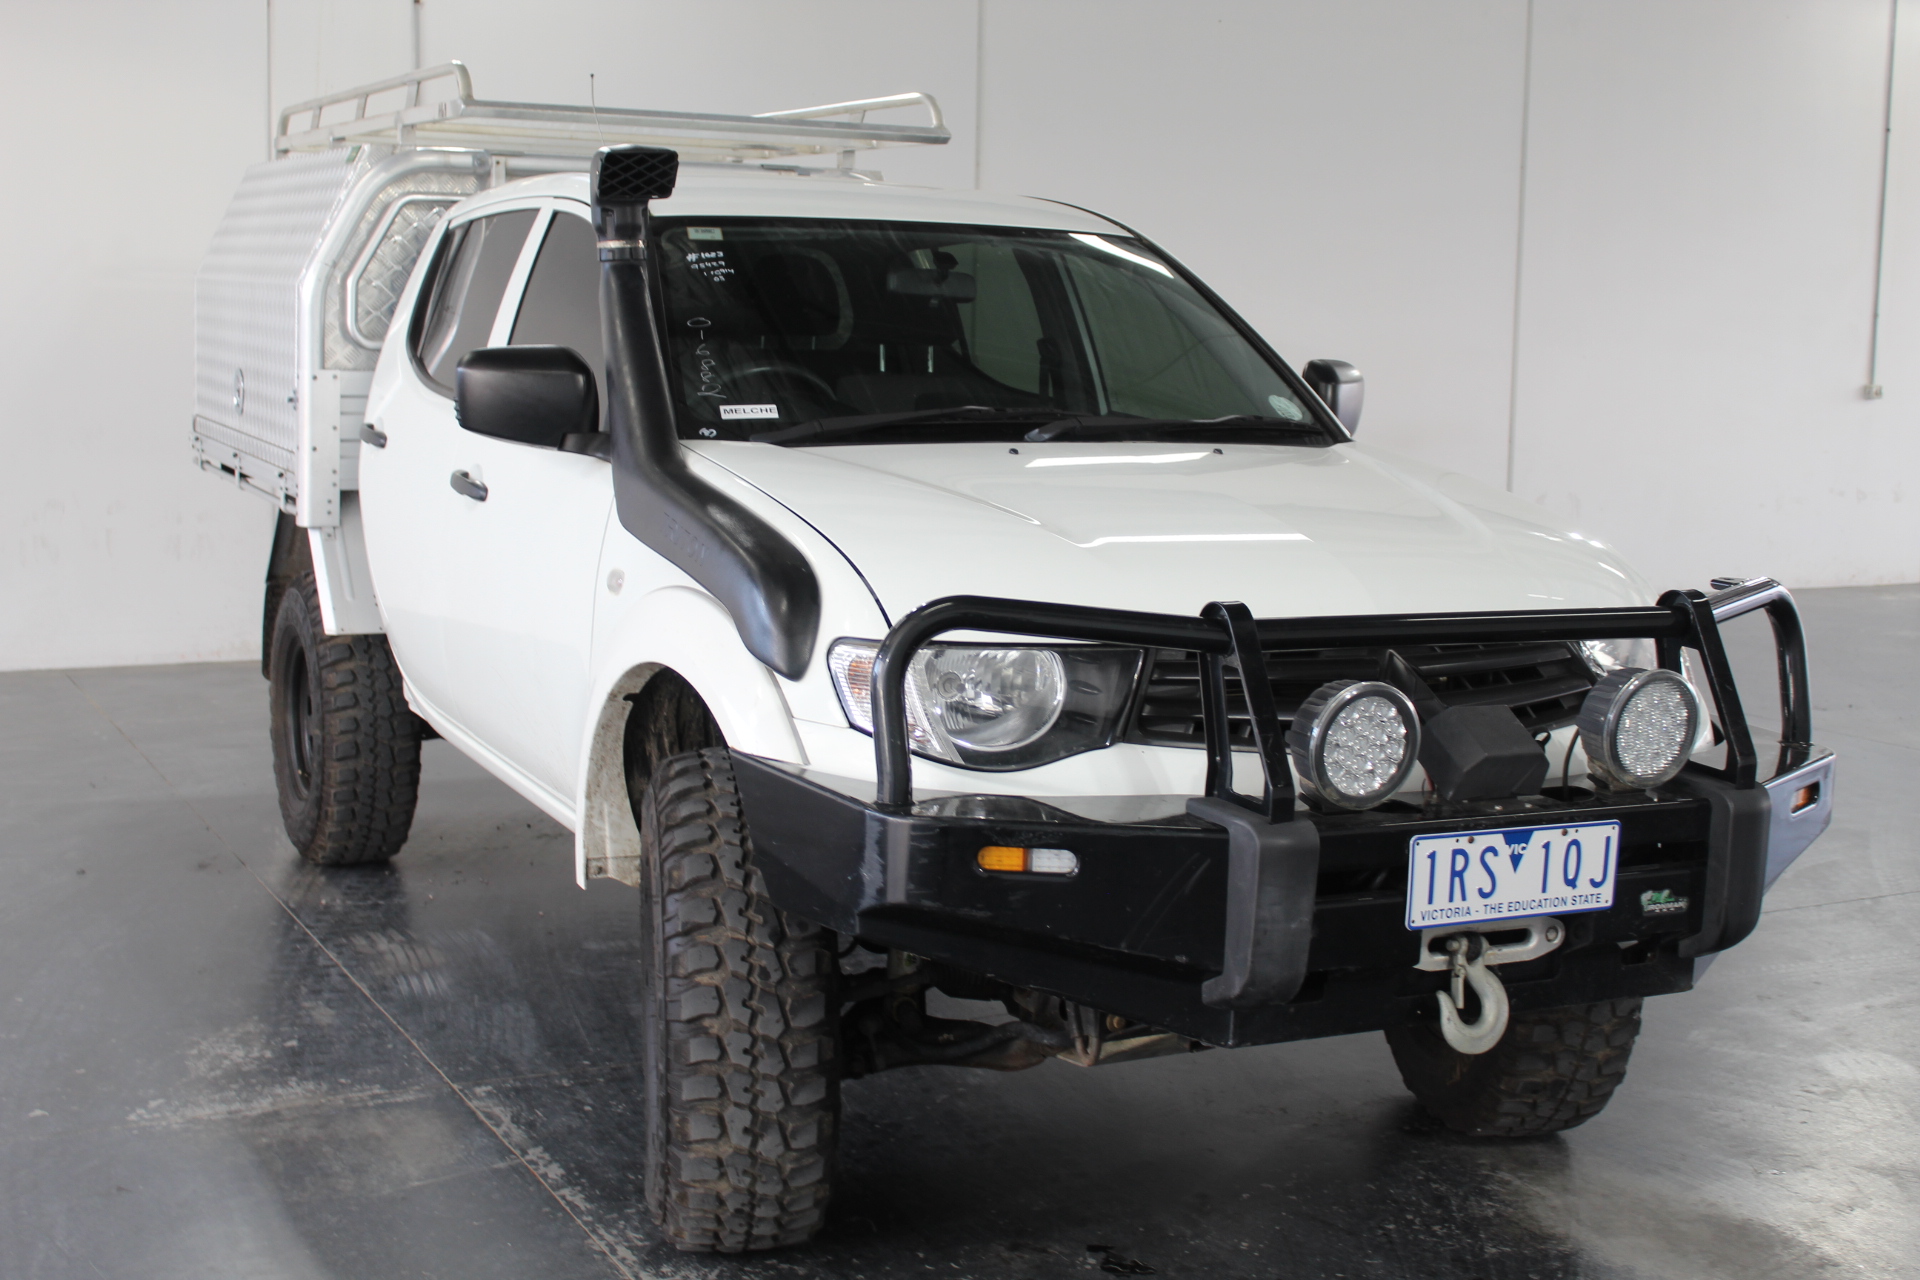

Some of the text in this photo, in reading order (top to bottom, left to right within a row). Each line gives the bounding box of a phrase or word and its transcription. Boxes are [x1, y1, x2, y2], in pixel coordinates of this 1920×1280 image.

[723, 407, 777, 415] MELCHE
[1506, 843, 1528, 855] VIC
[1427, 835, 1611, 905] 1RS 1QJ
[1421, 905, 1472, 921] VICTORIA
[1484, 901, 1504, 915] THE
[1507, 896, 1568, 913] EDUCATION
[1570, 892, 1602, 906] STATE
